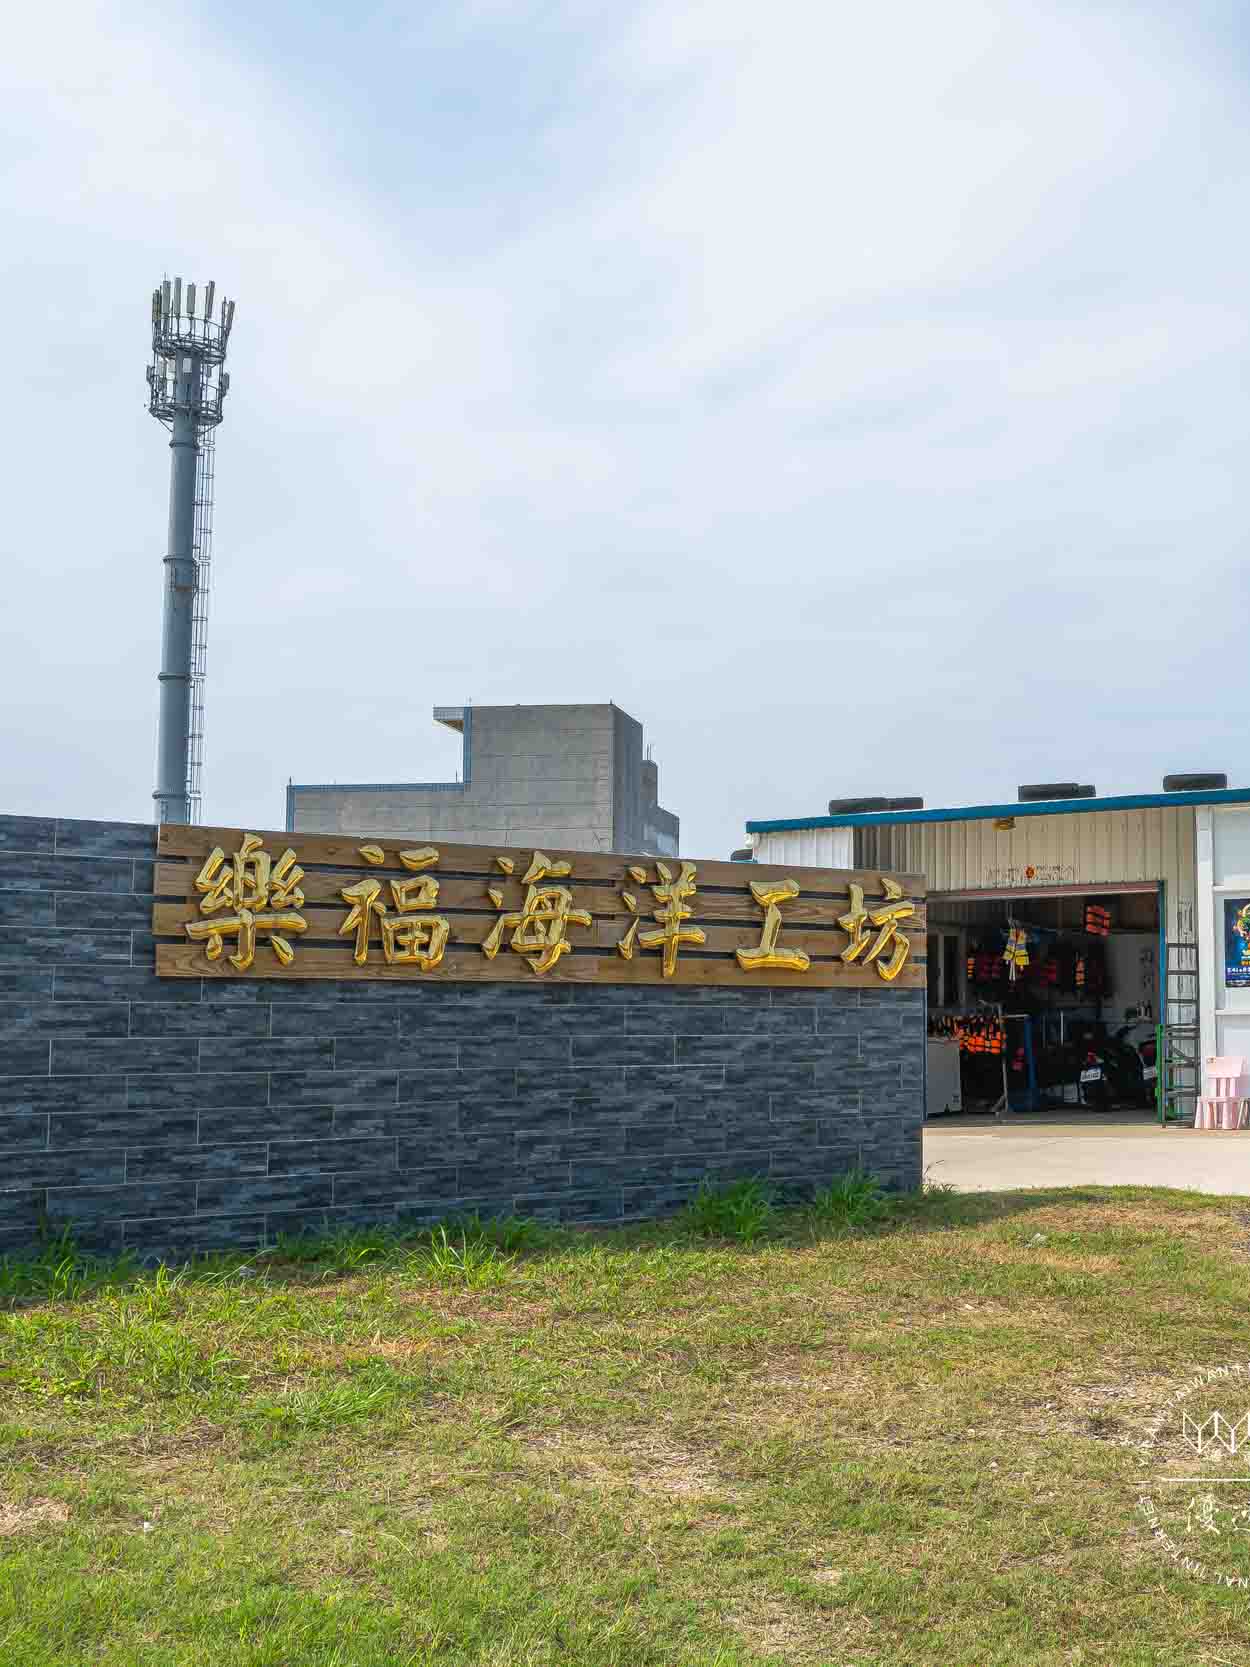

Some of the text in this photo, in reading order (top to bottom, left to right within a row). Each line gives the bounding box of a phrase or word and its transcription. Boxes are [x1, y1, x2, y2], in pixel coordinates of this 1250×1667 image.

[186, 832, 915, 982] 樂福海洋工坊
